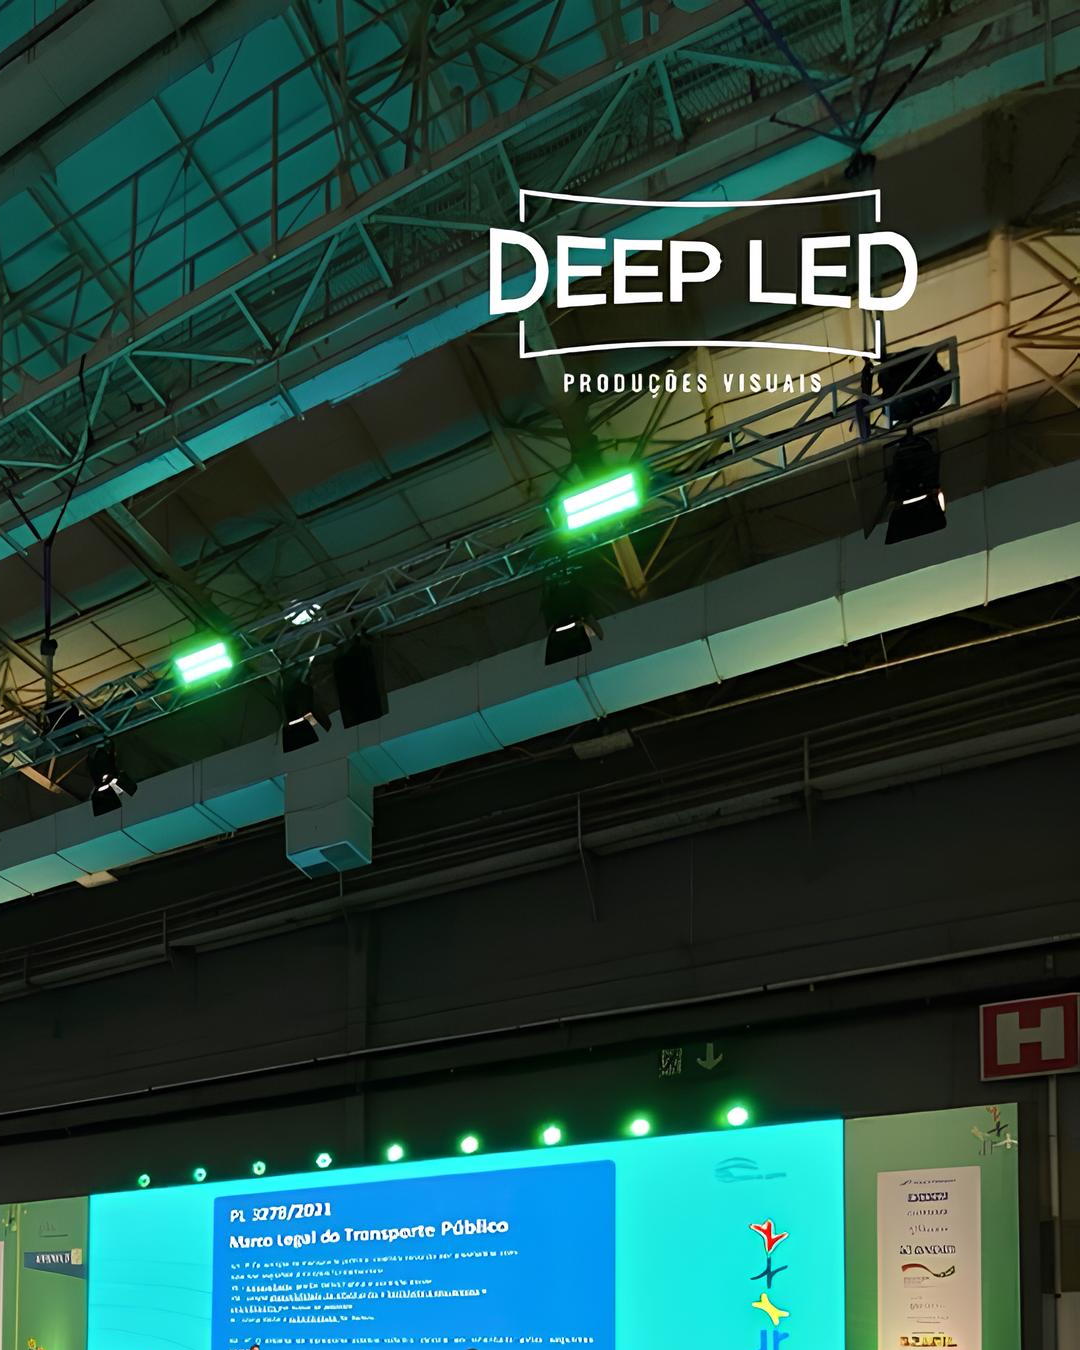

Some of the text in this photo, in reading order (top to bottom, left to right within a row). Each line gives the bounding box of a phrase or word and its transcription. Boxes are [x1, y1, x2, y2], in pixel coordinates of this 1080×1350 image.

[996, 1006, 1065, 1066] H
[344, 1225, 435, 1243] Transporte
[441, 1218, 510, 1237] Público
